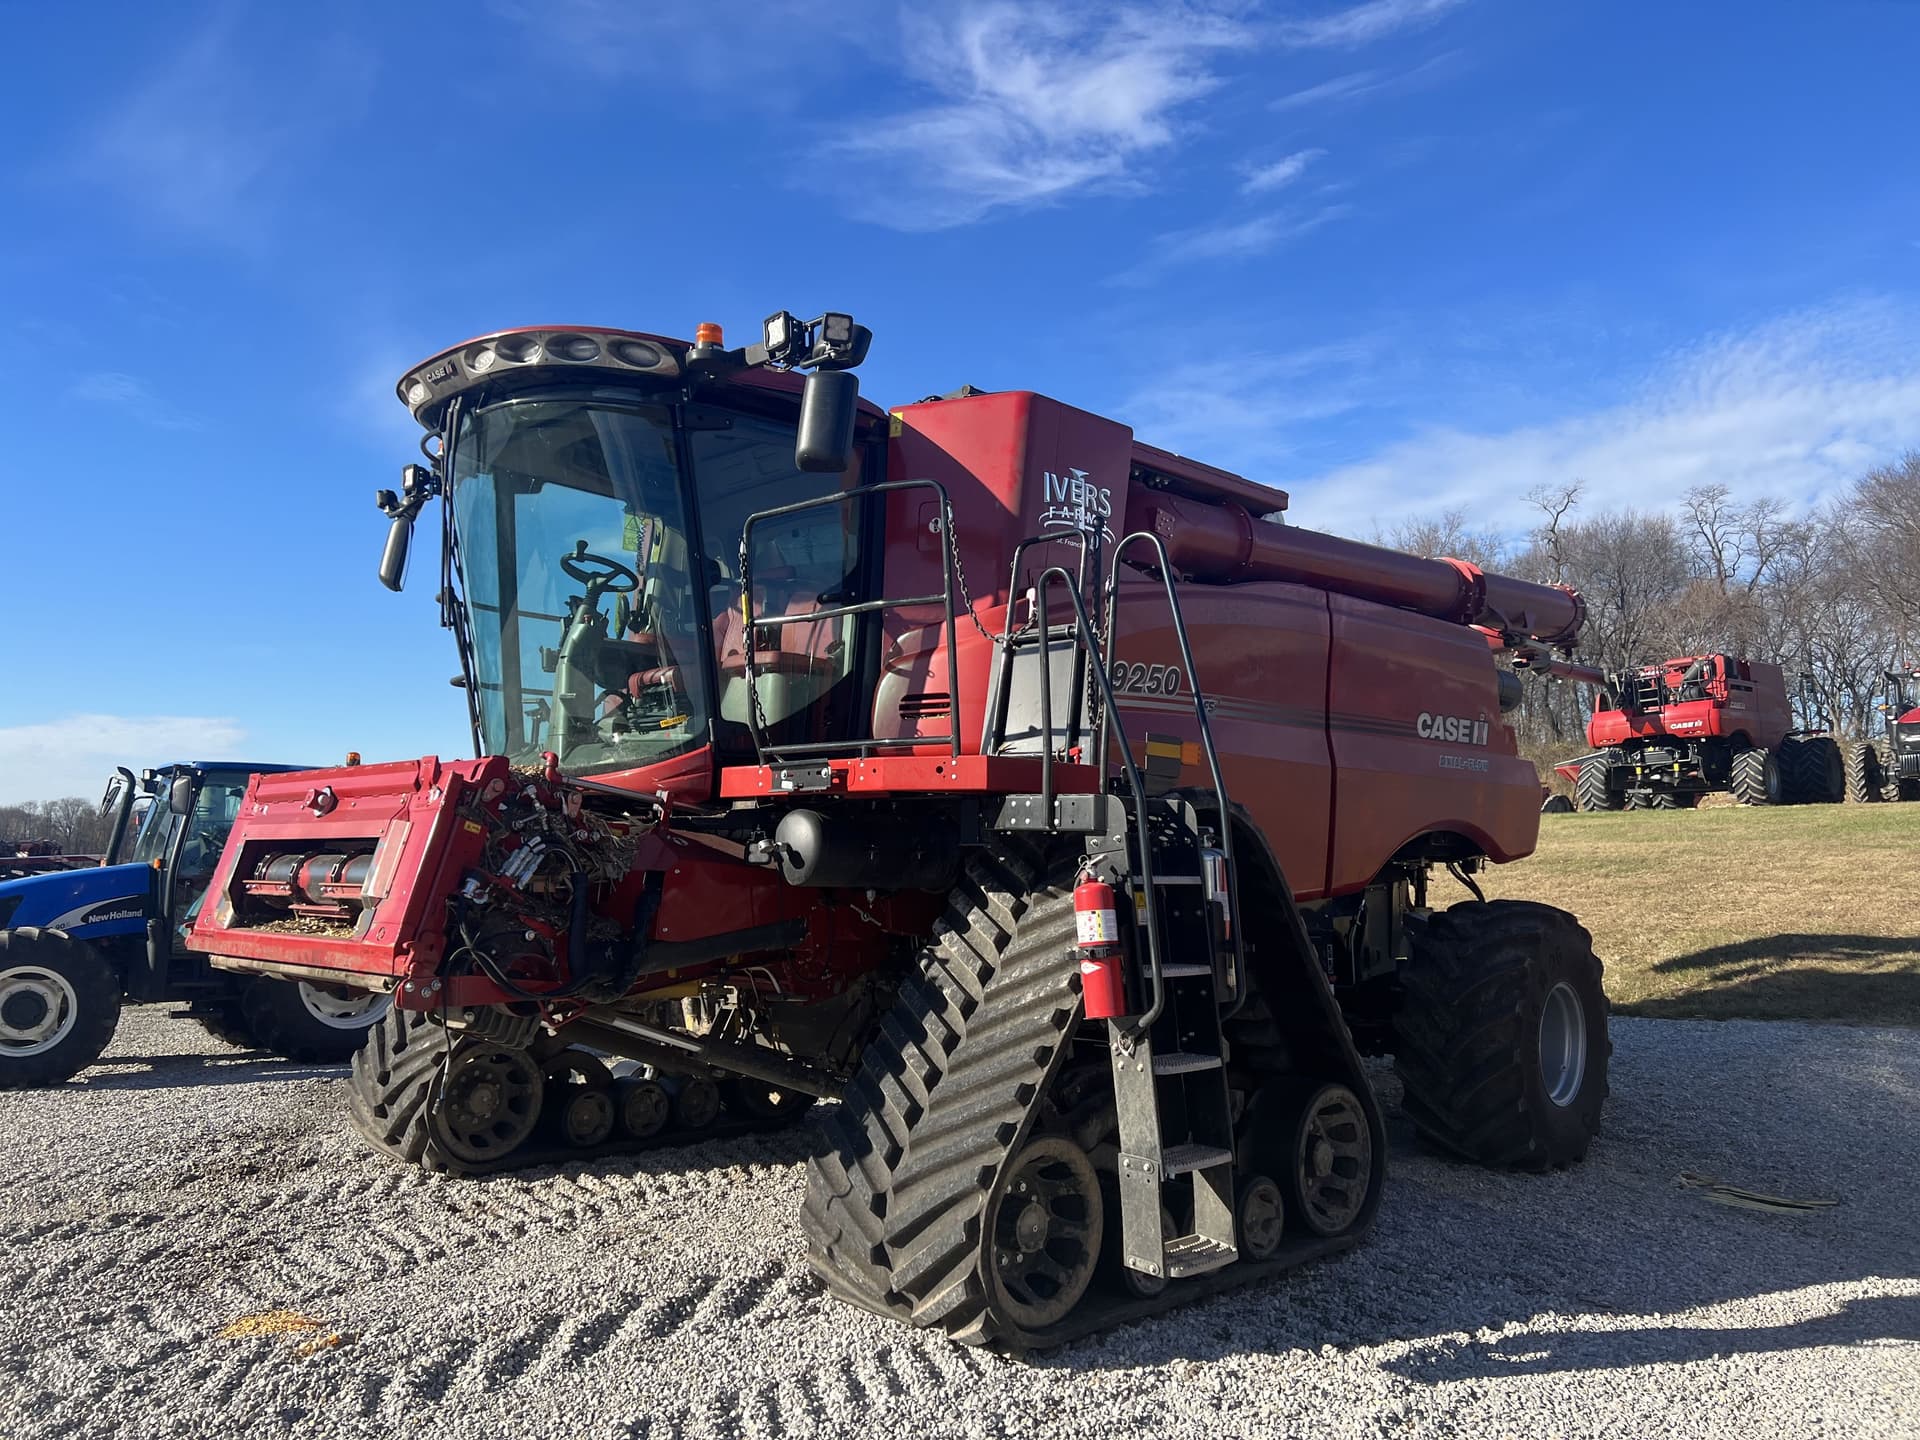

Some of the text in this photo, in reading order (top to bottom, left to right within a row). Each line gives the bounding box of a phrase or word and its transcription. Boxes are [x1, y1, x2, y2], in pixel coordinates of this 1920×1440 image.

[426, 367, 446, 383] CASE
[1043, 471, 1111, 518] IVERS
[1049, 506, 1107, 526] FARM
[1112, 661, 1181, 697] 9250
[1417, 712, 1471, 743] CASE
[88, 909, 143, 924] New Holland
